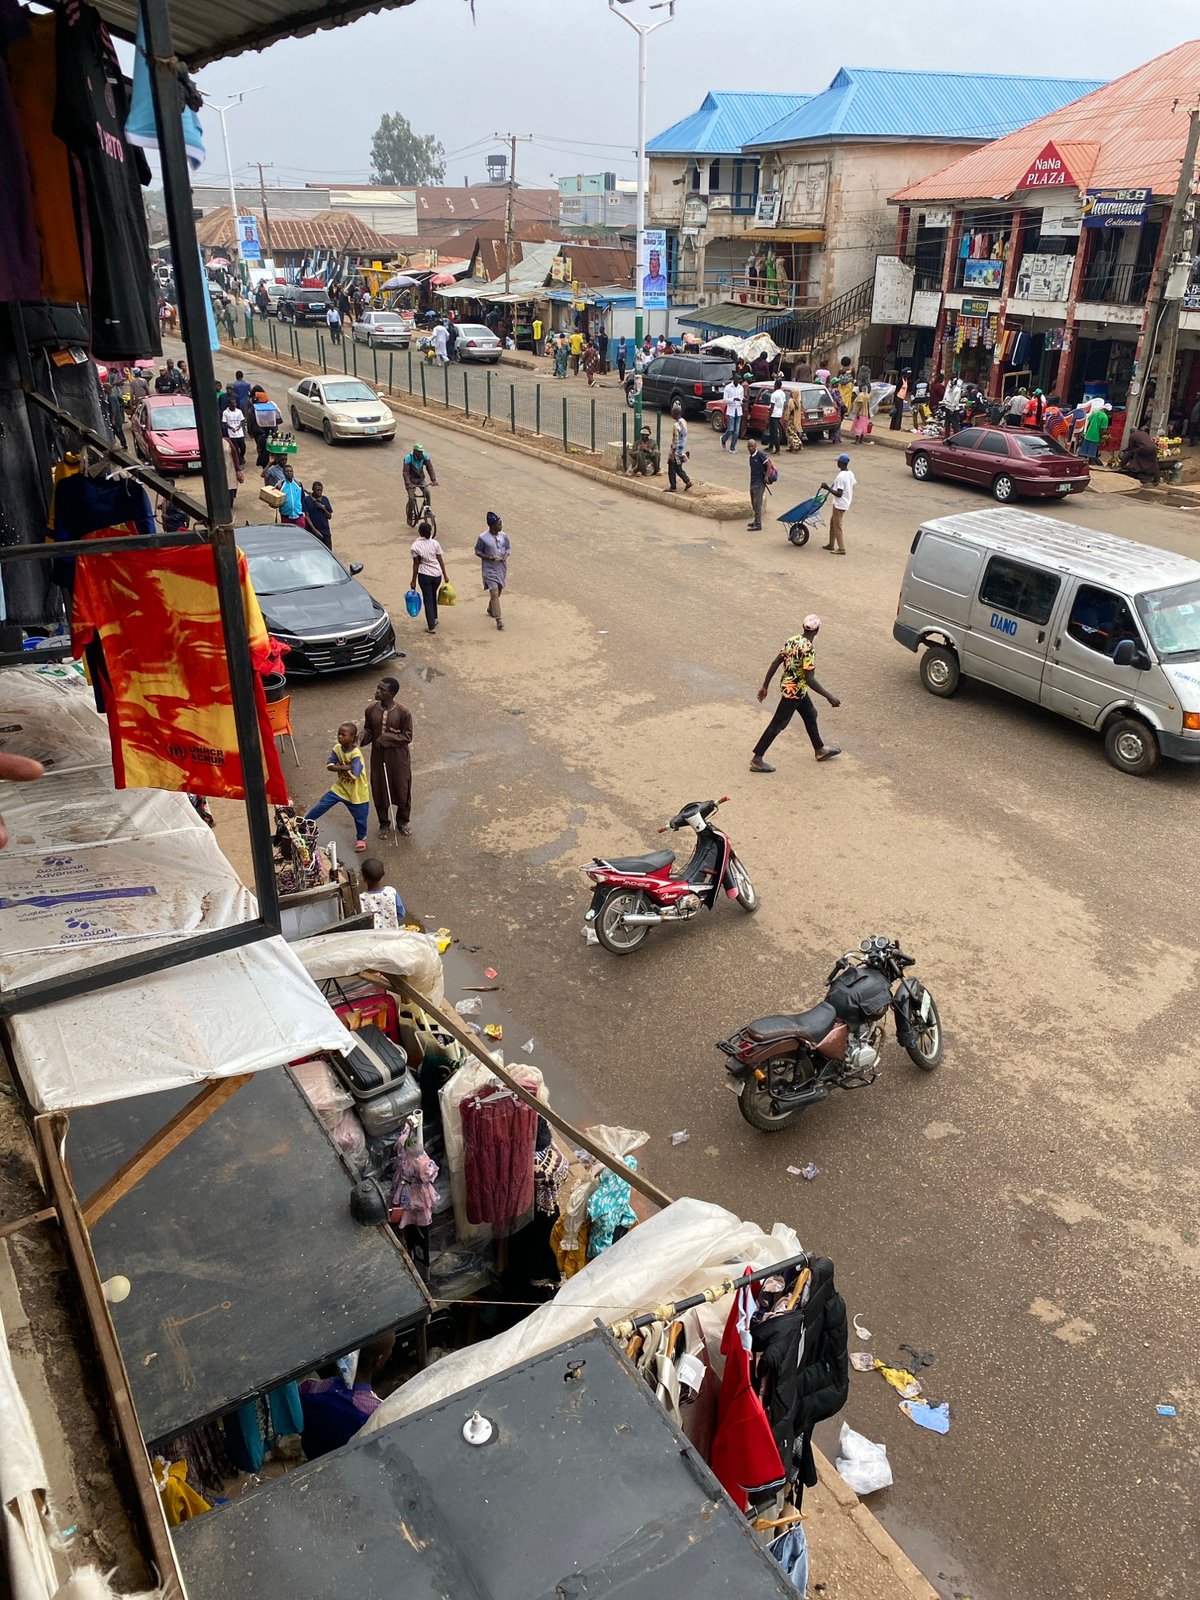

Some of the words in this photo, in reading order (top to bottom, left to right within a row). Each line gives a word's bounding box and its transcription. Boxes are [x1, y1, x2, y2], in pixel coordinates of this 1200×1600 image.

[1035, 158, 1061, 171] NaNa
[1026, 171, 1066, 185] PLAZA
[1104, 217, 1142, 227] Collection
[990, 612, 1018, 637] DANO
[188, 746, 224, 757] UNHCR
[190, 754, 225, 765] ACNUR
[35, 868, 89, 879] Advanced
